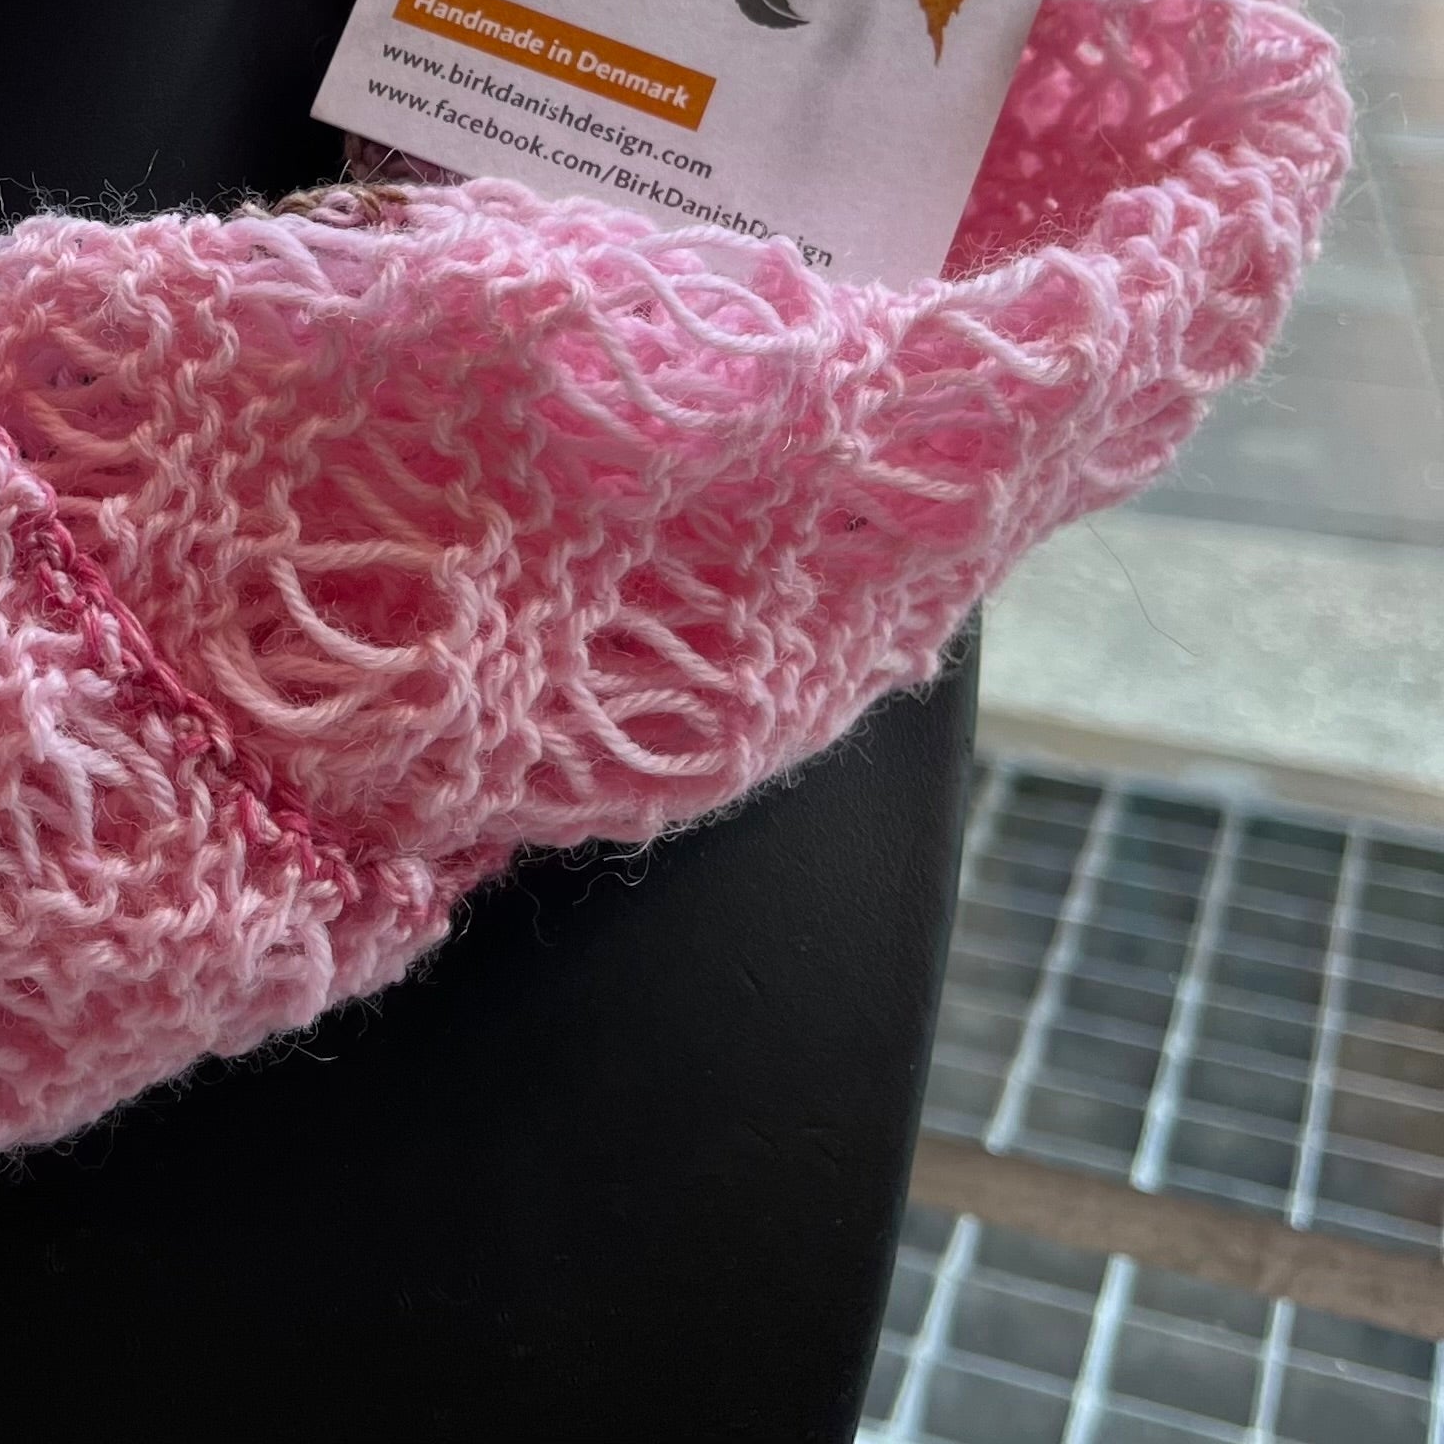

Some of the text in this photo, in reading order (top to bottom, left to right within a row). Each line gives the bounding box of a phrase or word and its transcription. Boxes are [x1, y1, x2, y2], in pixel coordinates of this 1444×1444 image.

[383, 43, 713, 179] www.birkdanishdesign.com
[547, 39, 573, 67] in
[576, 50, 691, 109] Denmark
[368, 78, 833, 268] www.facebook.com/BirkDanishDign
